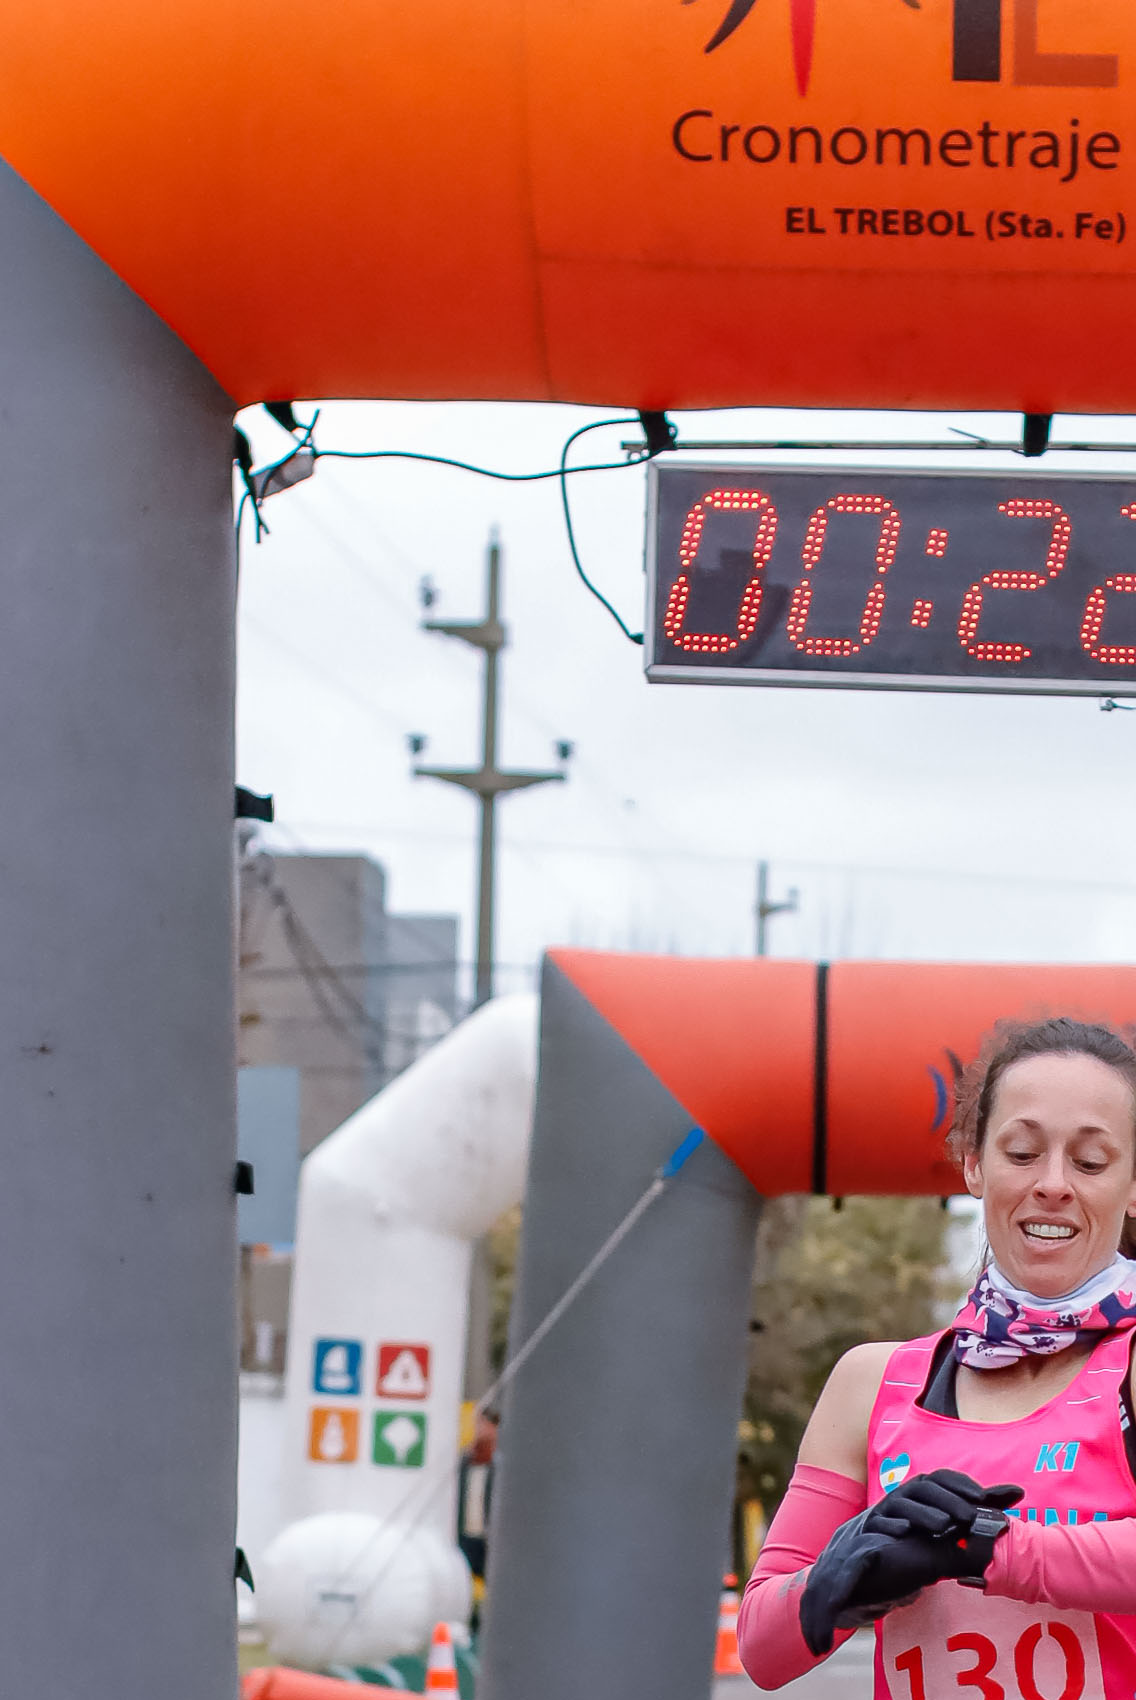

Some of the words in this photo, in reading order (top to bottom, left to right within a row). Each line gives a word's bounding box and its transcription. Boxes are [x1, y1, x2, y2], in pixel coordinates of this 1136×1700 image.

[672, 109, 1120, 183] Cronometraje
[785, 206, 826, 234] EL
[833, 208, 975, 237] TREBOL
[985, 210, 1064, 241] (Sta.
[1075, 212, 1126, 244] Fe)
[1034, 1441, 1081, 1473] K1
